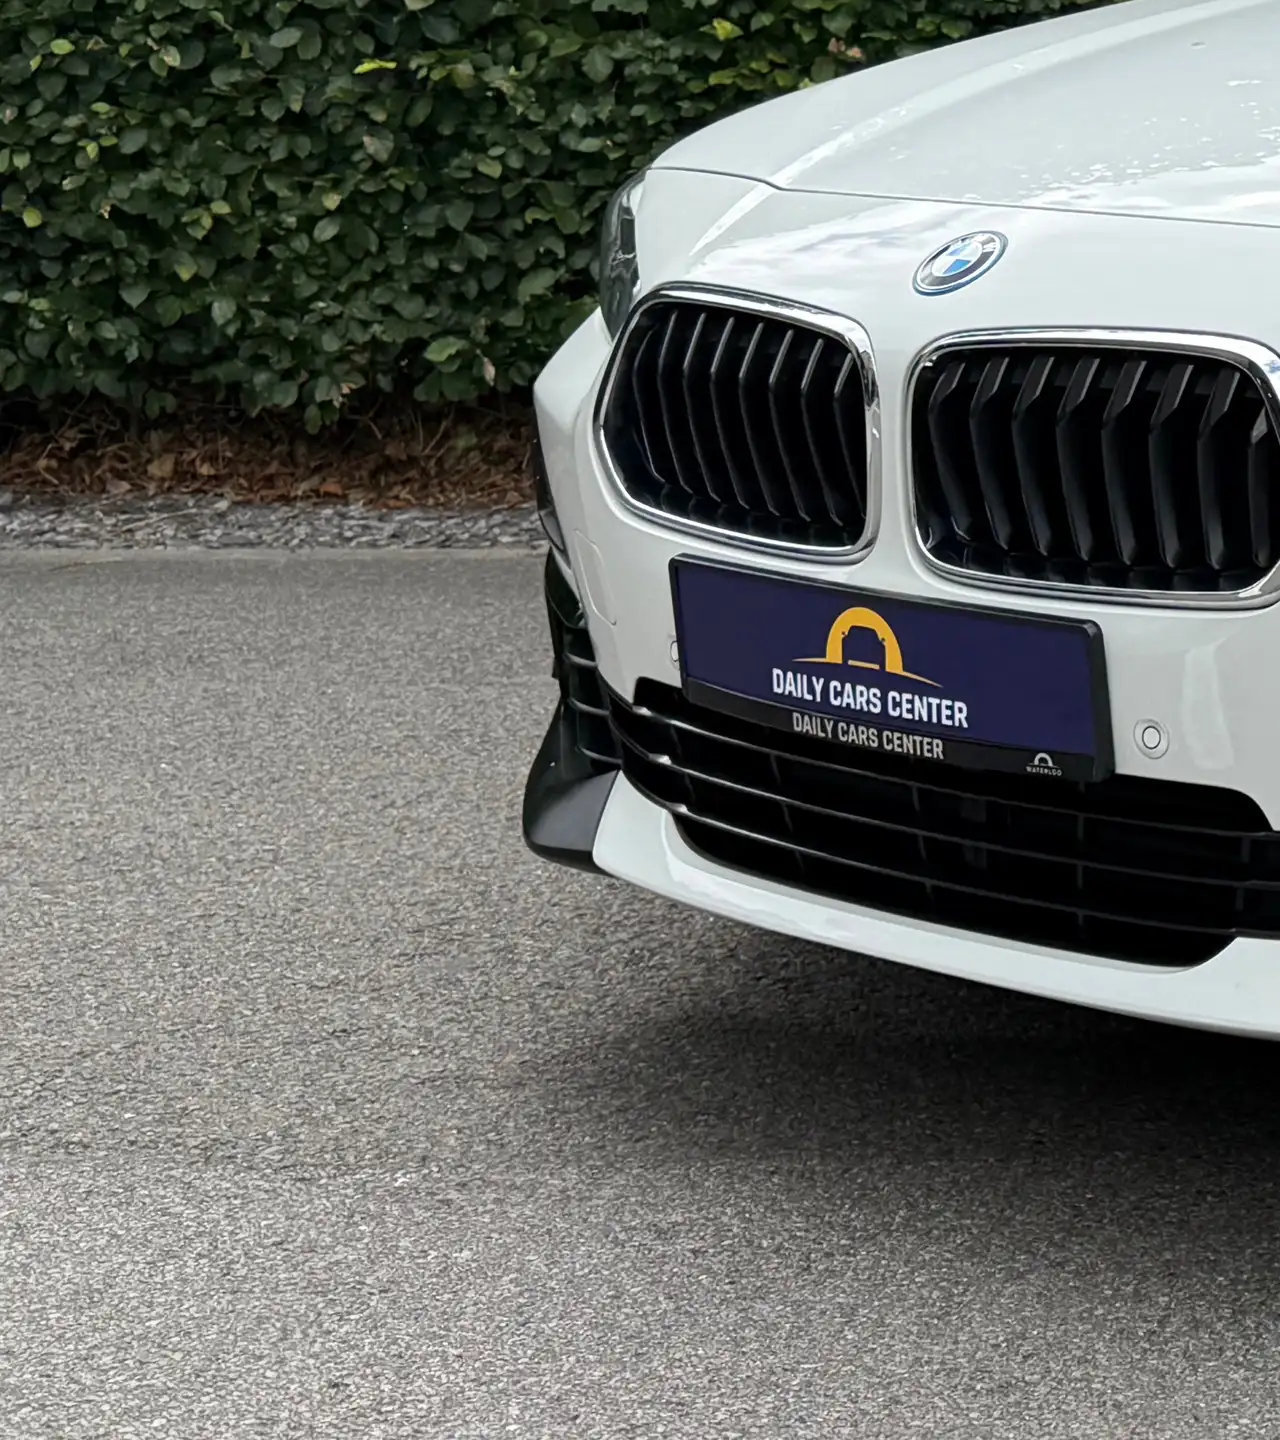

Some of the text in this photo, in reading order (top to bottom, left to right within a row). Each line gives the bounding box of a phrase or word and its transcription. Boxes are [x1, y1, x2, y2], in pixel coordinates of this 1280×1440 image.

[772, 668, 968, 728] DAILY CARS CENTER
[792, 712, 944, 760] DAILY CARS CENTER
